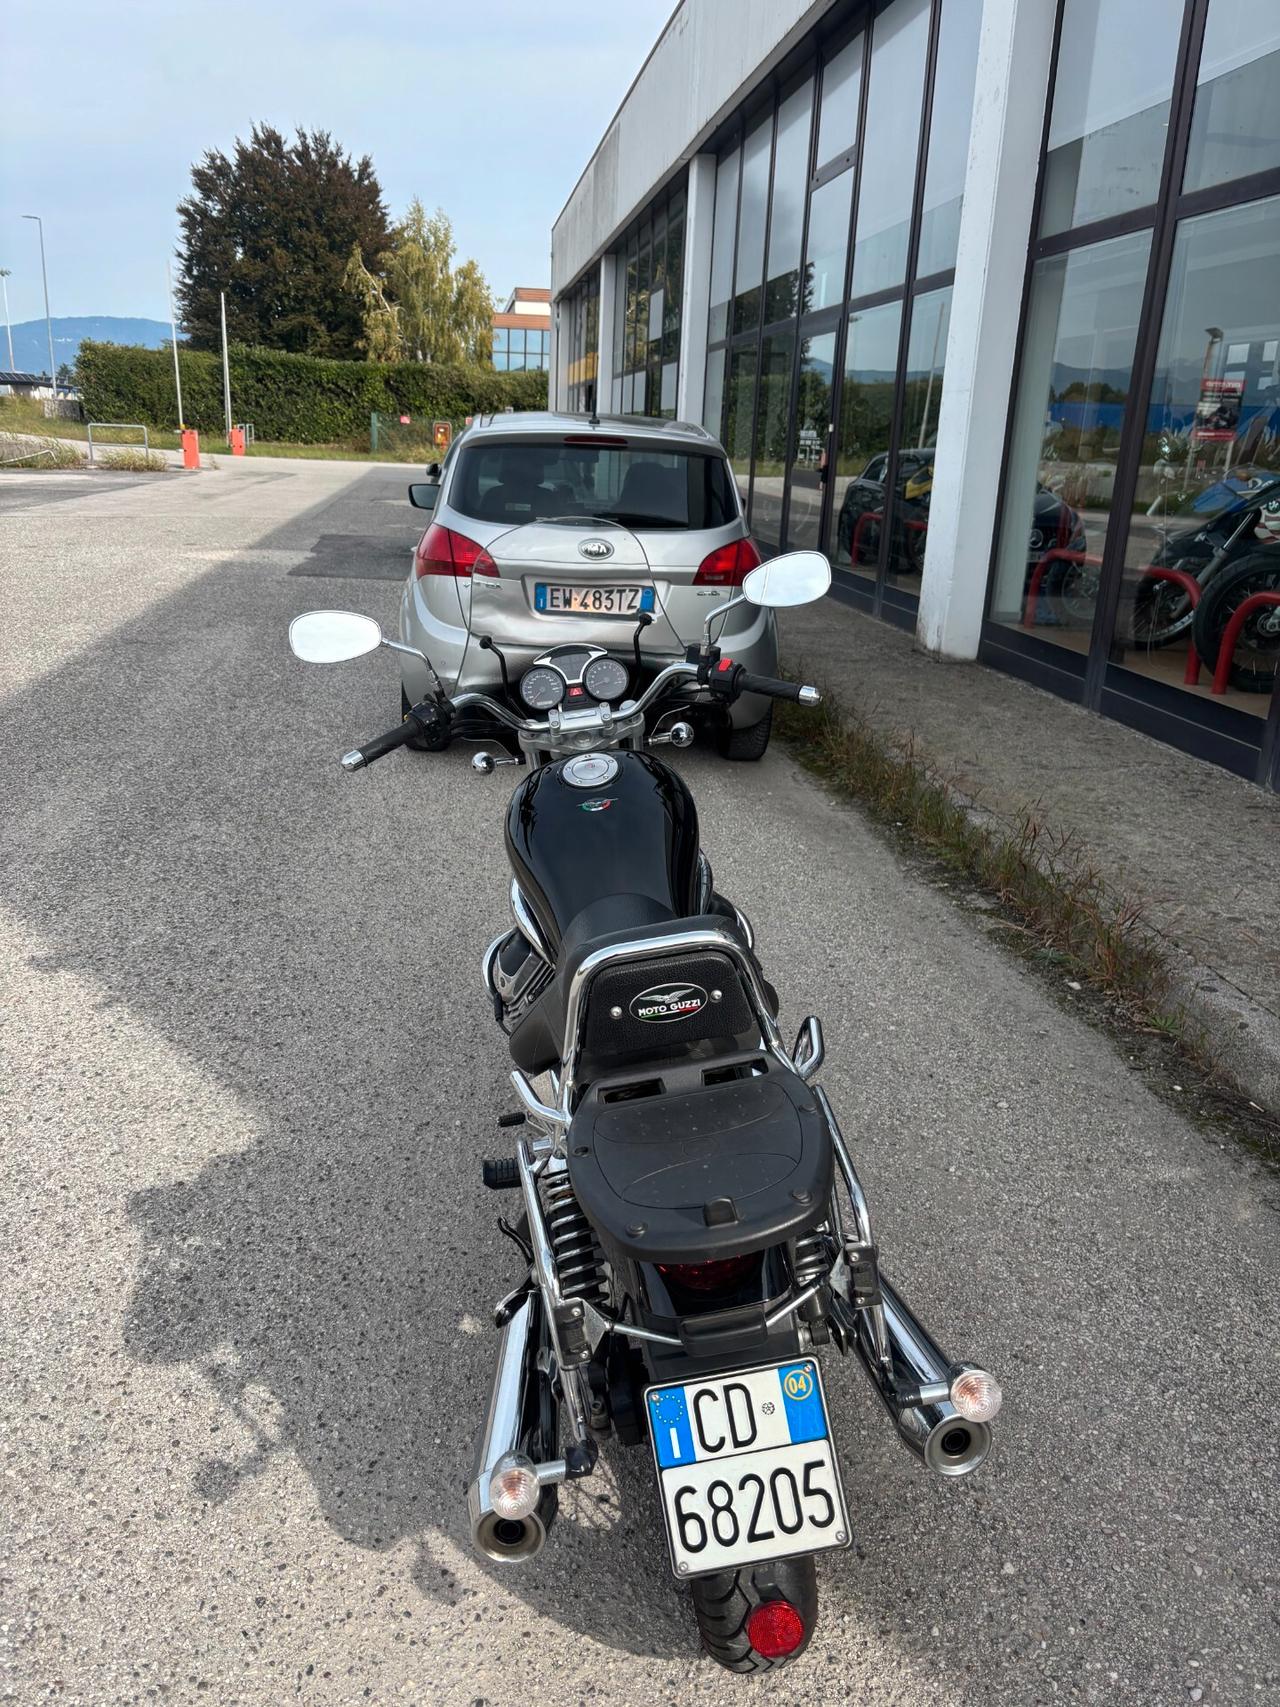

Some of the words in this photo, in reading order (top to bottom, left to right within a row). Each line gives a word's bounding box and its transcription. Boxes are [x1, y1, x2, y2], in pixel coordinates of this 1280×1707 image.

[638, 1005, 667, 1016] MOTO
[670, 999, 701, 1010] GUZZI
[669, 1427, 681, 1459] I
[693, 1383, 757, 1453] CD
[787, 1376, 806, 1394] 04
[674, 1459, 835, 1553] 68205
